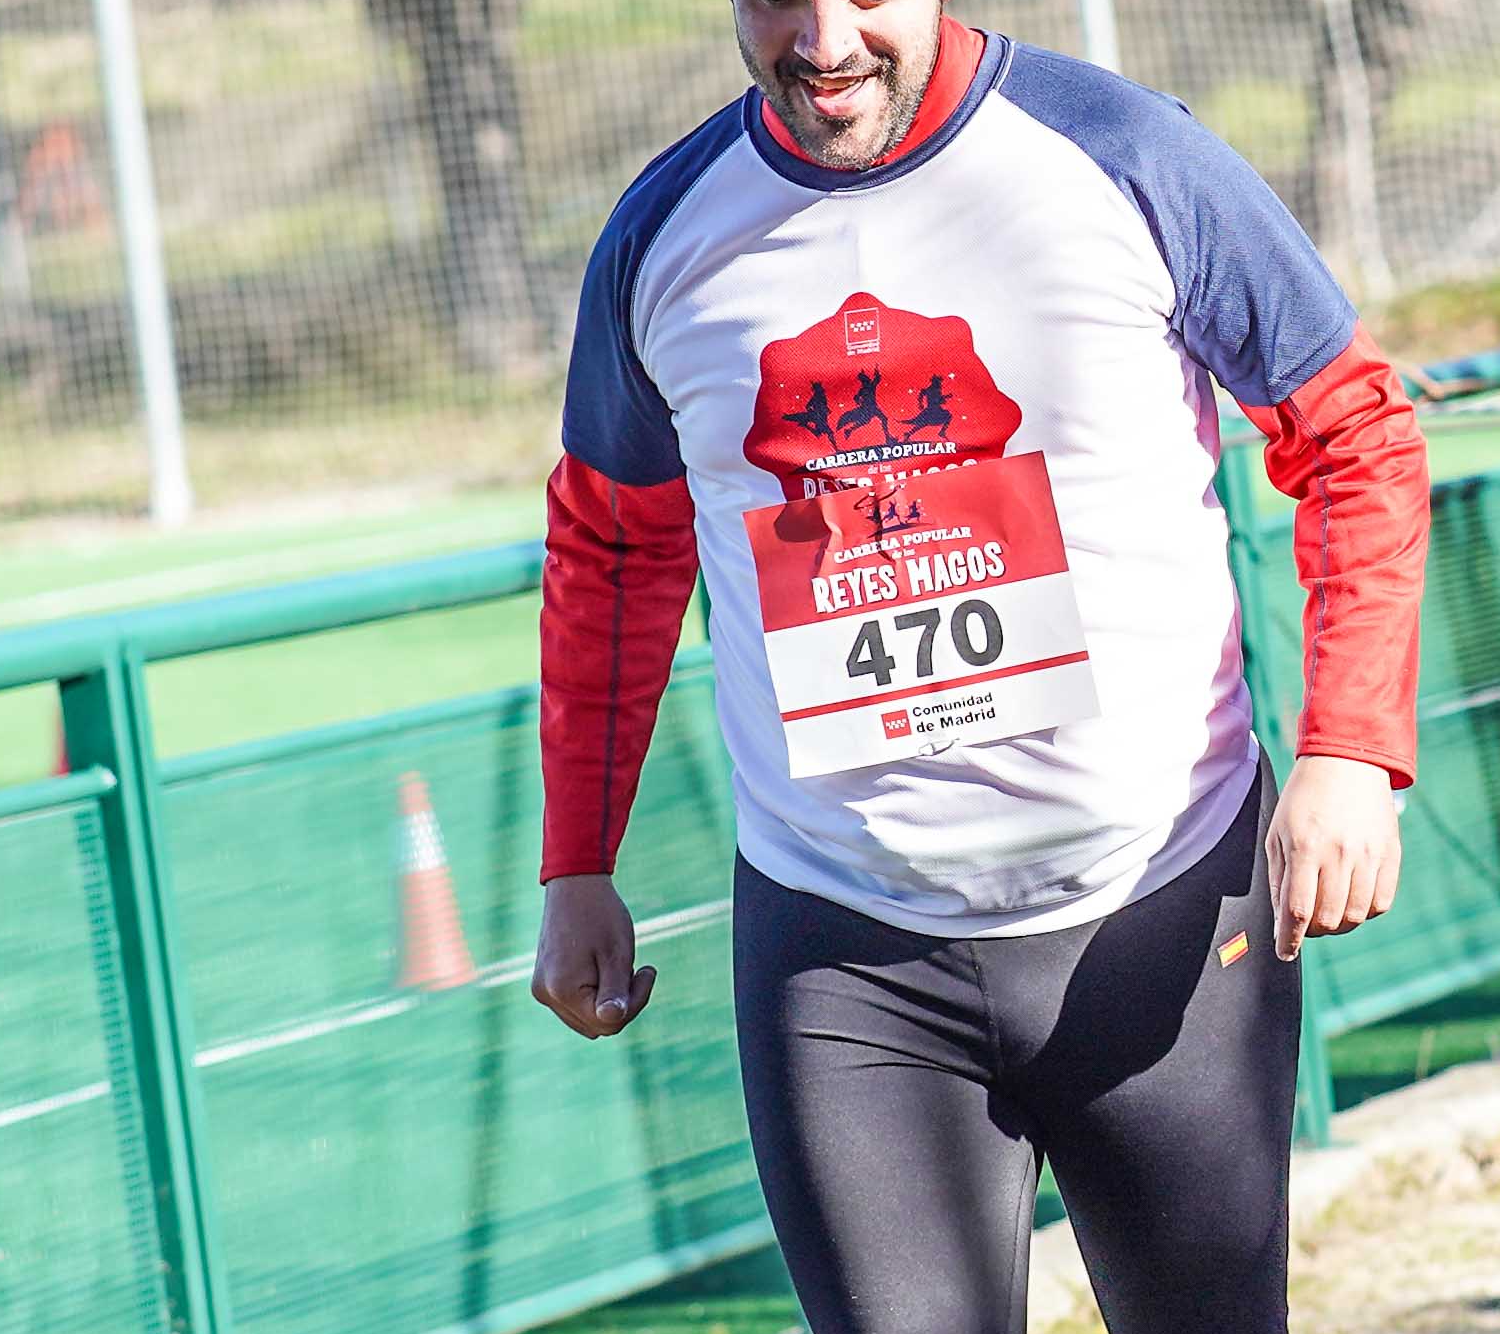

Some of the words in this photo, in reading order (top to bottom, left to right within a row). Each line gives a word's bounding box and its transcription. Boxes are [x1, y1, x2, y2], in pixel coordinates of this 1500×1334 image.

[805, 450, 880, 471] CARRERA
[882, 442, 957, 460] POPULAR
[833, 539, 900, 564] CARRERA
[902, 526, 973, 546] POPULAR
[811, 564, 899, 614] REYES
[906, 541, 1007, 597] MAGOS
[846, 599, 1004, 686] 470
[912, 692, 994, 718] Comunidad
[916, 720, 935, 733] de
[940, 707, 997, 729] Madrid
